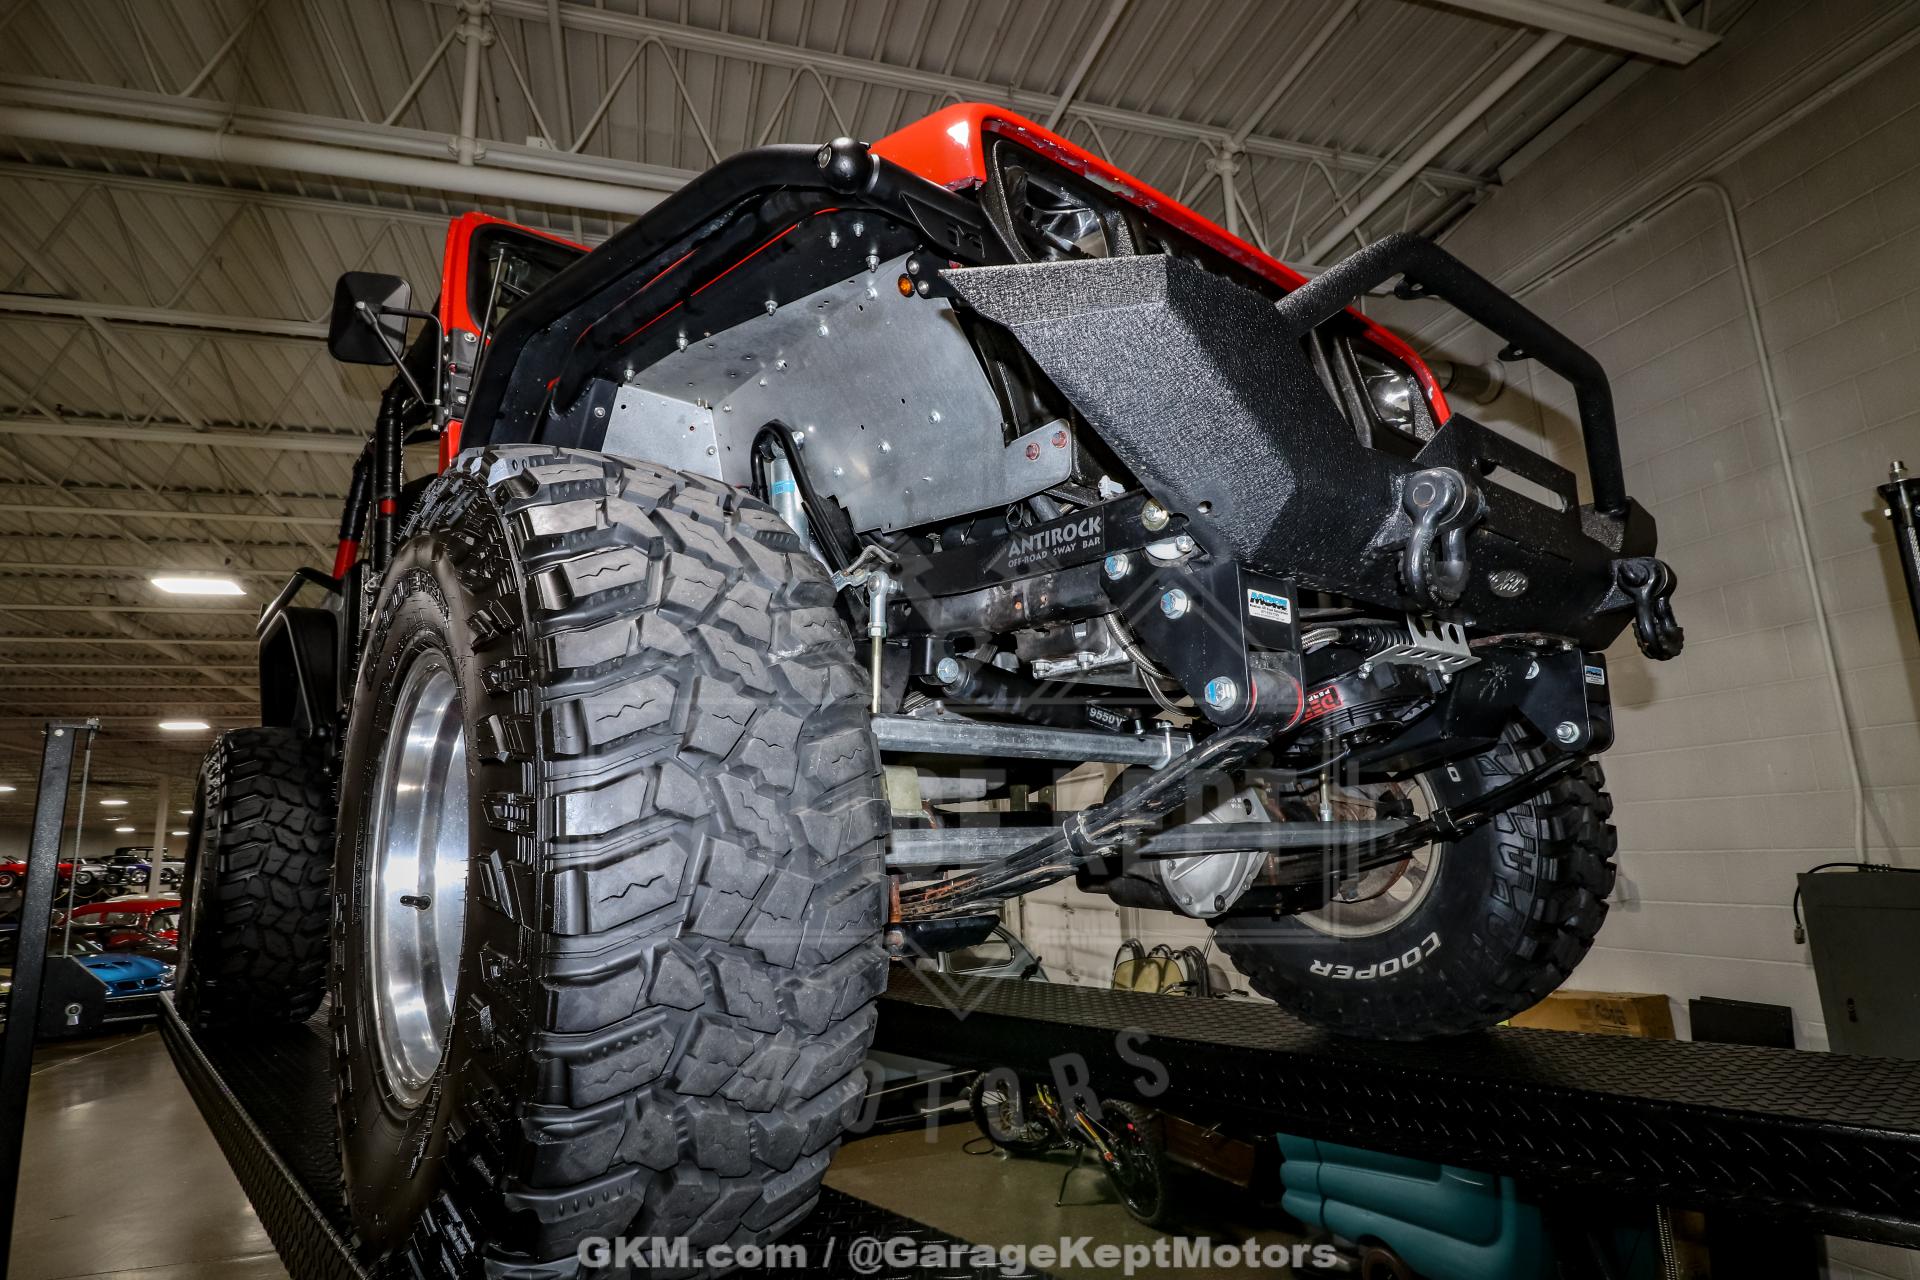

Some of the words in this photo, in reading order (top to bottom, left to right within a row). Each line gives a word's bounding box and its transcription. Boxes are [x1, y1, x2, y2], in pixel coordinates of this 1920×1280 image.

[1007, 516, 1102, 558] ANTIROCK
[1007, 551, 1048, 568] OFF-ROAD
[1052, 543, 1077, 557] SWAY
[1082, 537, 1101, 549] BAR
[1309, 931, 1442, 980] COOPER
